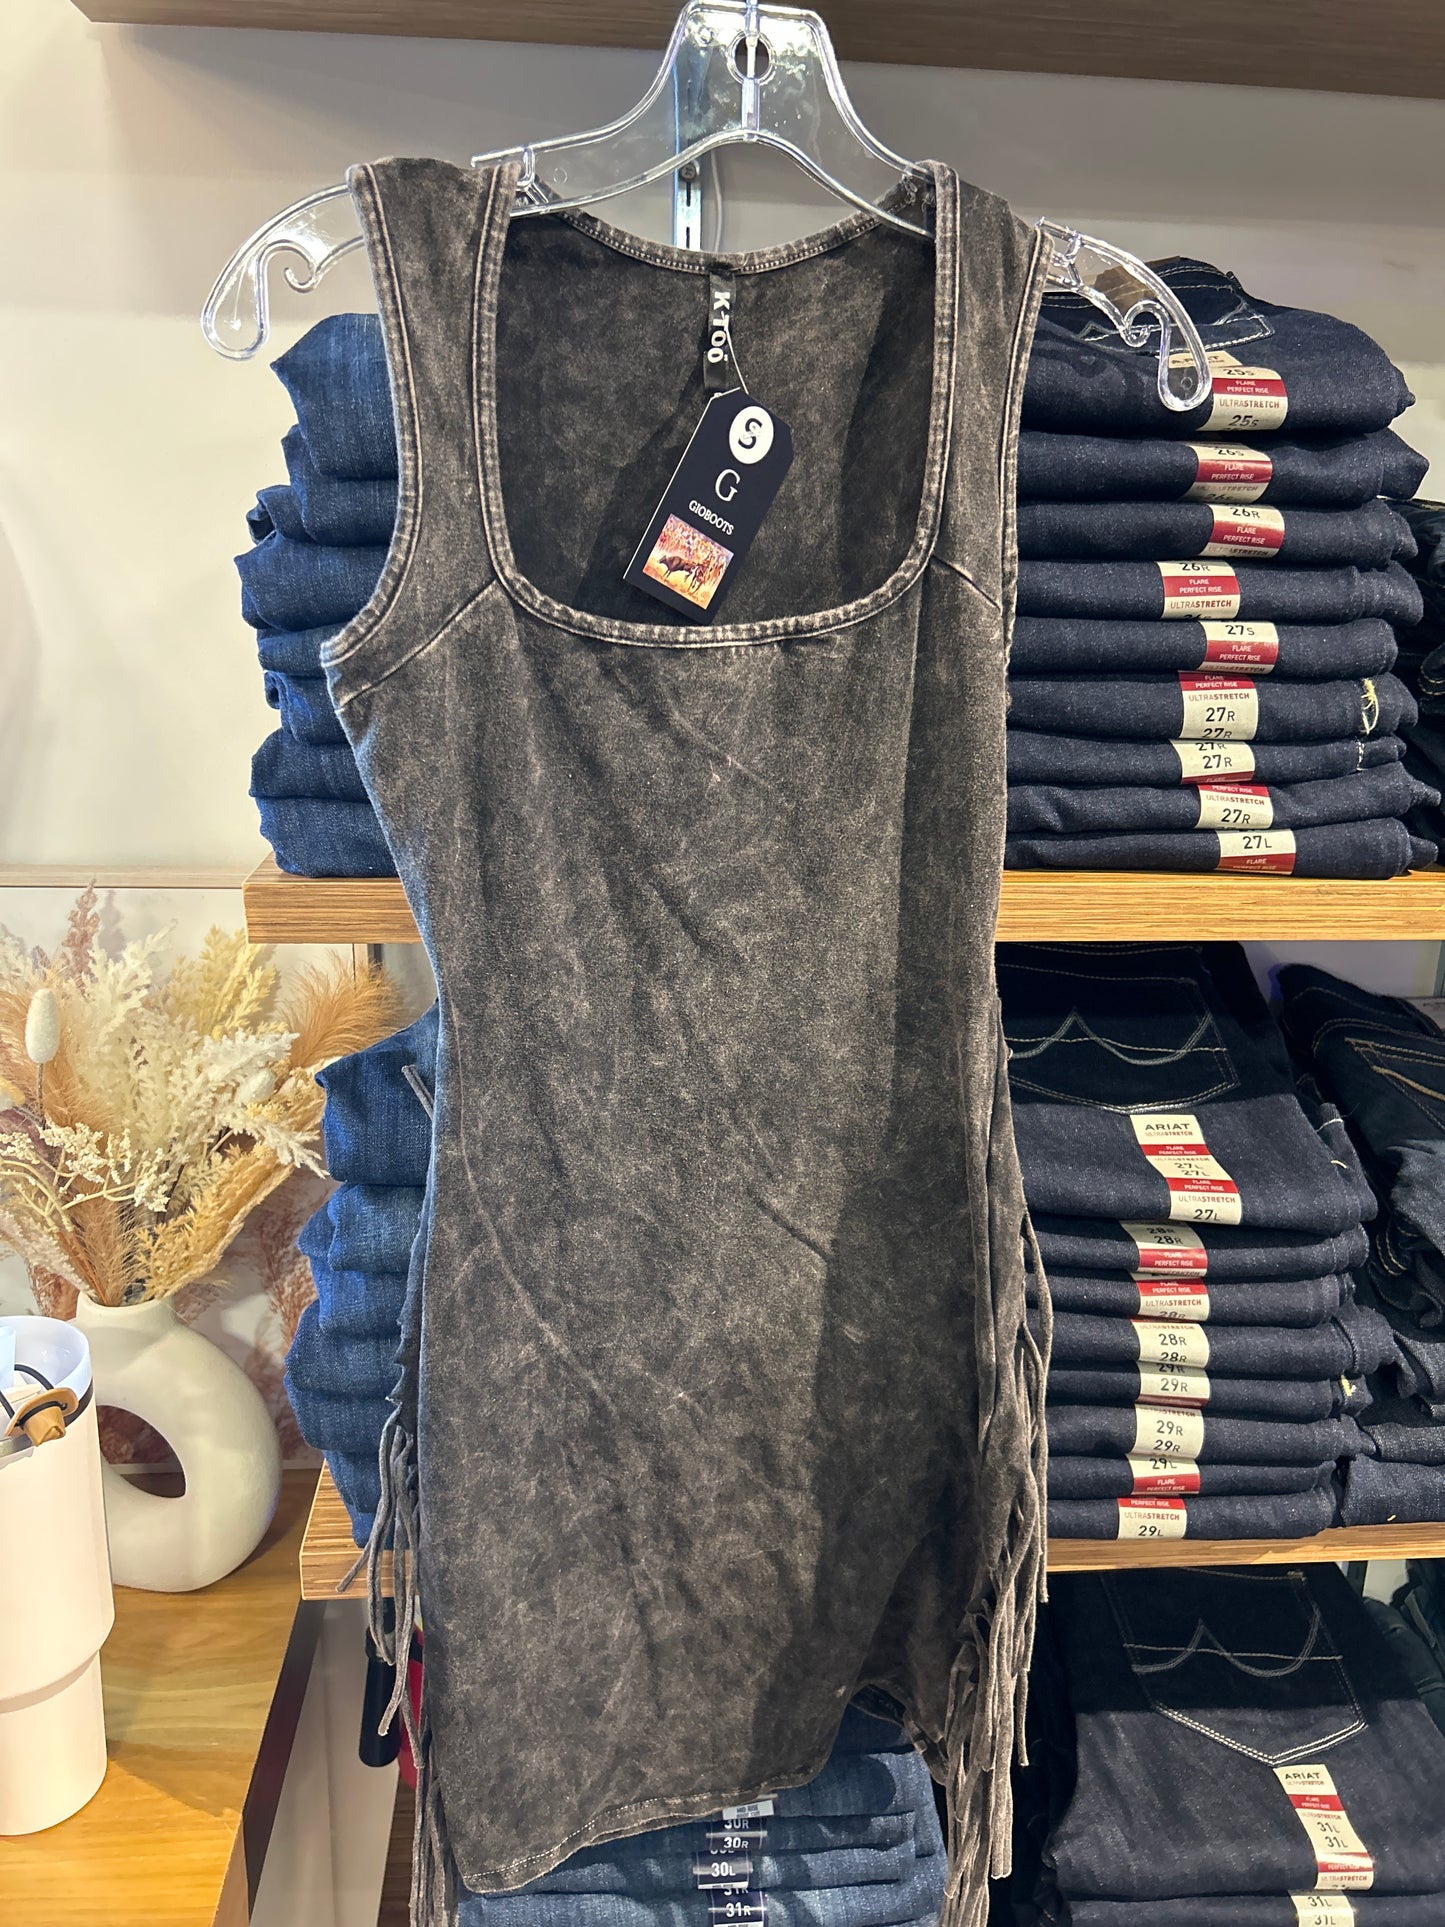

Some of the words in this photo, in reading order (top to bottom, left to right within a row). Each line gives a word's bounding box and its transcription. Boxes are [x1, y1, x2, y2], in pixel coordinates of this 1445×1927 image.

[1220, 399, 1280, 408] ULTRASTRETCH
[738, 418, 763, 450] S
[715, 468, 741, 502] G
[688, 500, 735, 536] GIOBOOTS
[1230, 507, 1260, 518] 26R
[1236, 526, 1256, 534] FLARE
[1223, 534, 1251, 543] PERFECT
[1251, 536, 1266, 544] RISE
[1180, 562, 1210, 572] 26R
[1170, 600, 1232, 609] ULTRASTRETCH
[1188, 692, 1250, 702] ULTRASTRETCH
[1206, 707, 1236, 722] 27R
[1201, 728, 1232, 738] 27R
[1195, 742, 1226, 751] 27R
[1202, 754, 1232, 770] 27R
[1206, 794, 1264, 806] ULTRASTRETCH
[1221, 808, 1251, 824] 27R
[1242, 836, 1272, 850] 27L
[1178, 1195, 1236, 1204] ULTRASTRETCH
[1193, 1208, 1221, 1221] 27L
[1154, 1236, 1184, 1244] 28R
[1158, 1333, 1187, 1346] 28R
[1159, 1352, 1188, 1362] 28R
[1156, 1364, 1185, 1374] 29R
[1160, 1377, 1188, 1392] 29R
[1156, 1420, 1184, 1436] 29R
[1153, 1440, 1181, 1453] 29R
[1149, 1458, 1178, 1470] 29L
[1124, 1512, 1180, 1520] ULTRASTRETCH
[1138, 1525, 1164, 1537] 29L
[1285, 1772, 1320, 1780] ARIAT
[1317, 1821, 1341, 1834] 31L
[724, 1836, 749, 1849] 30R
[1324, 1836, 1348, 1848] 31L
[711, 1862, 736, 1878] 30L
[1308, 1896, 1332, 1908] 31L
[726, 1902, 752, 1918] 31R
[1314, 1914, 1336, 1926] 31L
